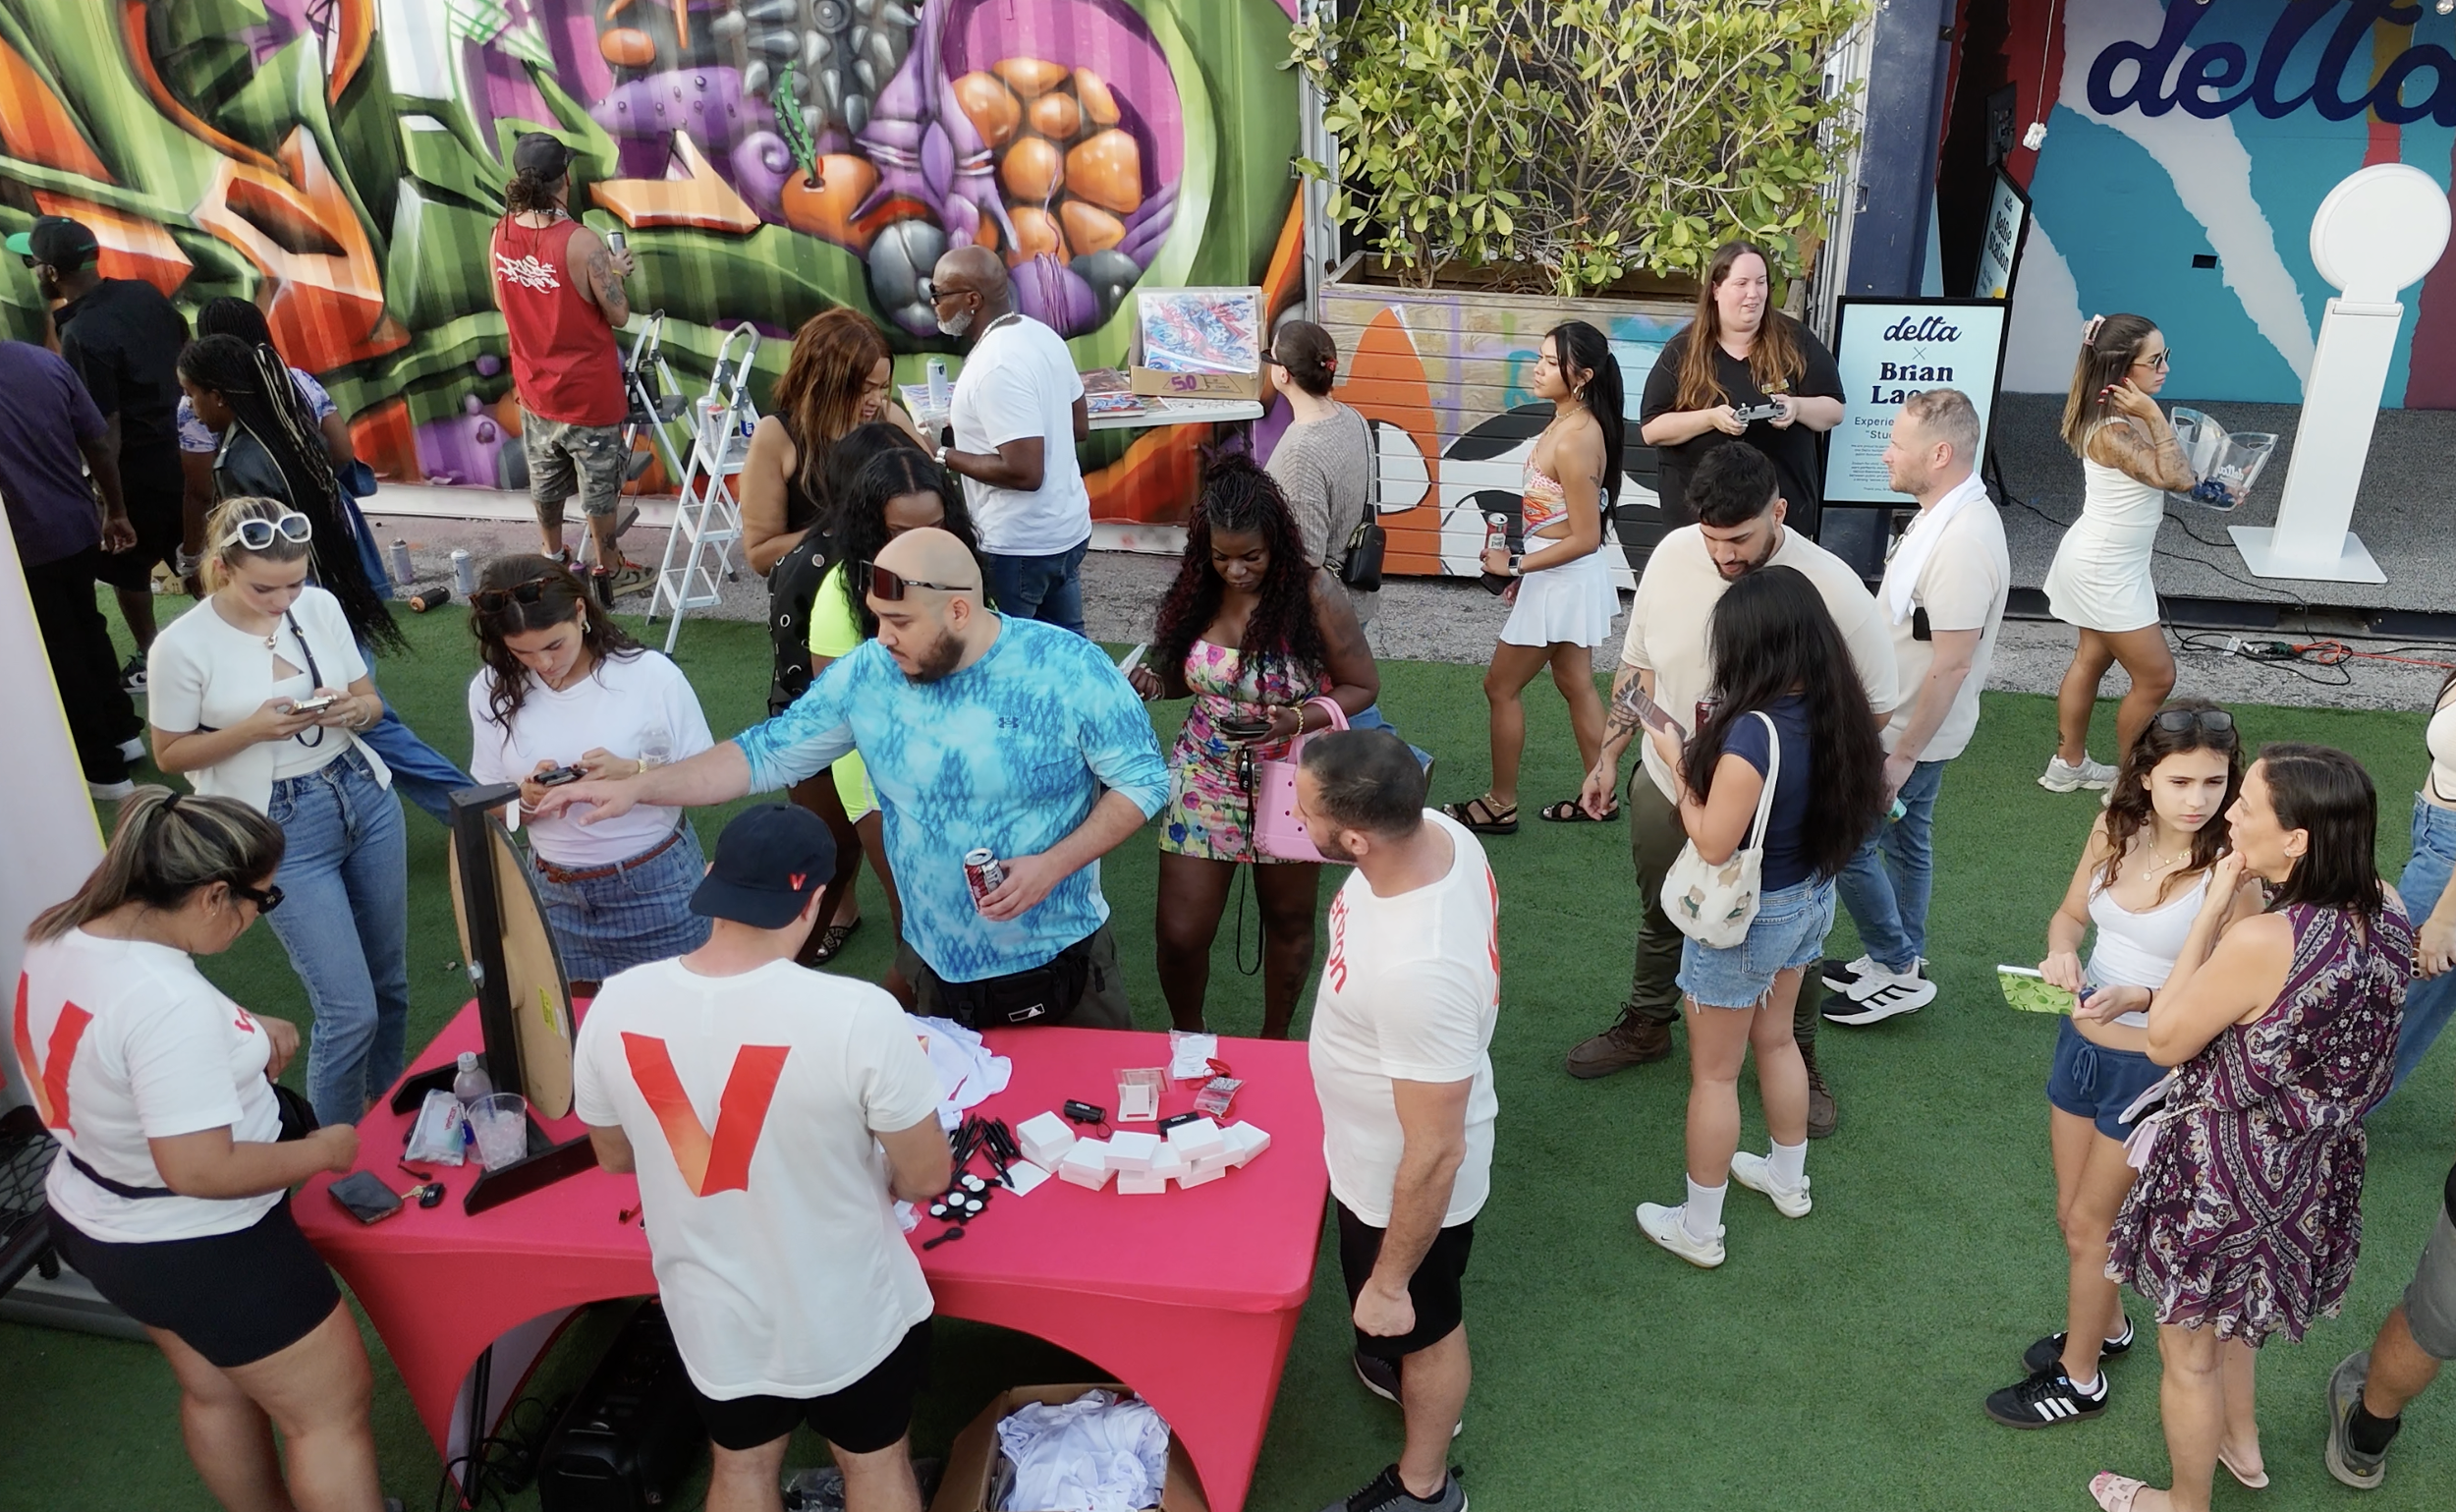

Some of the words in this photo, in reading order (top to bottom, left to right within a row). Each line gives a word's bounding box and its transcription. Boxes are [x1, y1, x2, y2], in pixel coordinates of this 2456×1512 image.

[2087, 0, 2456, 128] delta
[1994, 210, 2012, 247] Selfie
[1987, 231, 2009, 274] Station
[1883, 315, 1962, 343] delta
[1171, 374, 1198, 392] 50
[1879, 362, 1954, 382] Brian
[789, 872, 807, 891] V
[1329, 889, 1350, 995] erizon
[620, 1031, 792, 1198] V
